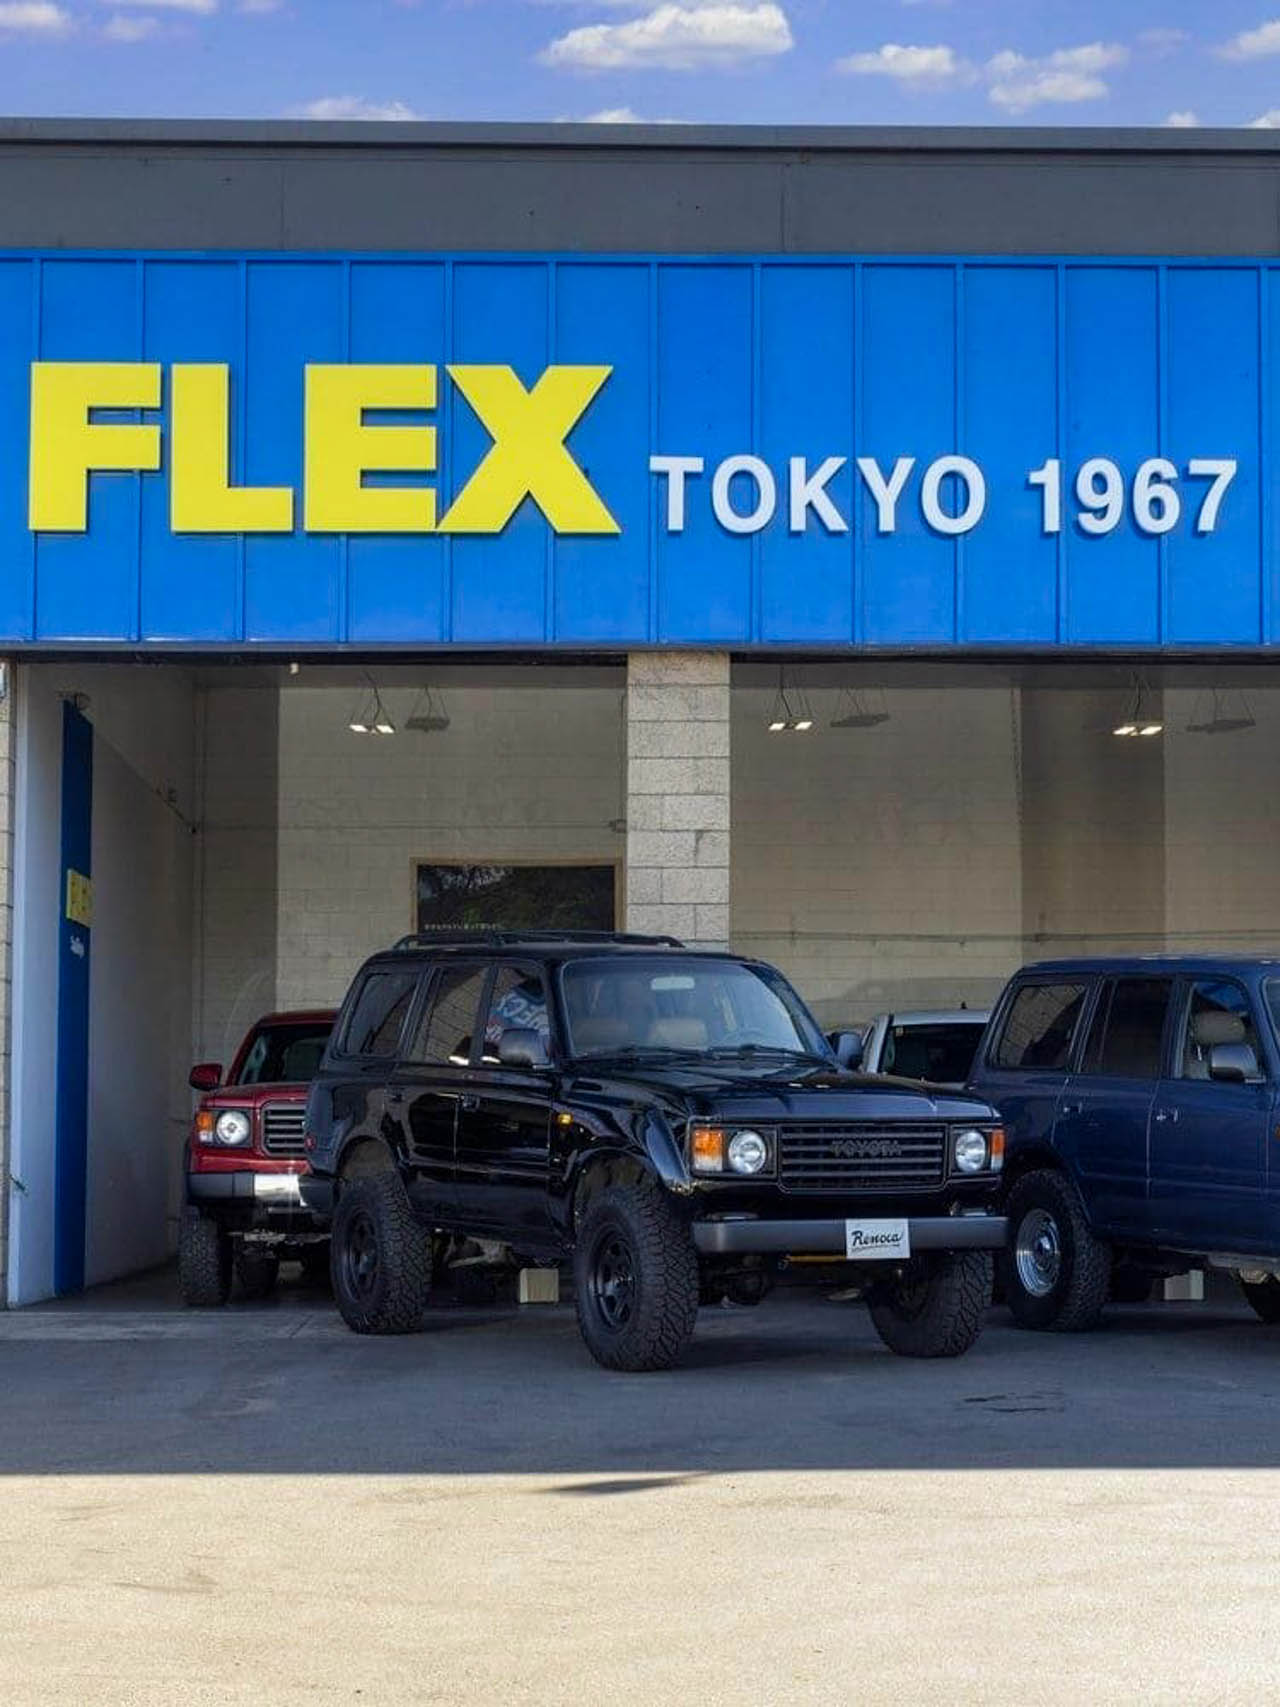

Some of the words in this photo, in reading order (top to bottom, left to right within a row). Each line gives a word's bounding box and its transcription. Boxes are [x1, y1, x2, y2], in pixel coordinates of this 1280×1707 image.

[28, 361, 622, 534] FLEX
[650, 454, 987, 535] TOKYO
[1028, 458, 1238, 536] 1967
[831, 1139, 903, 1157] TOYOTA
